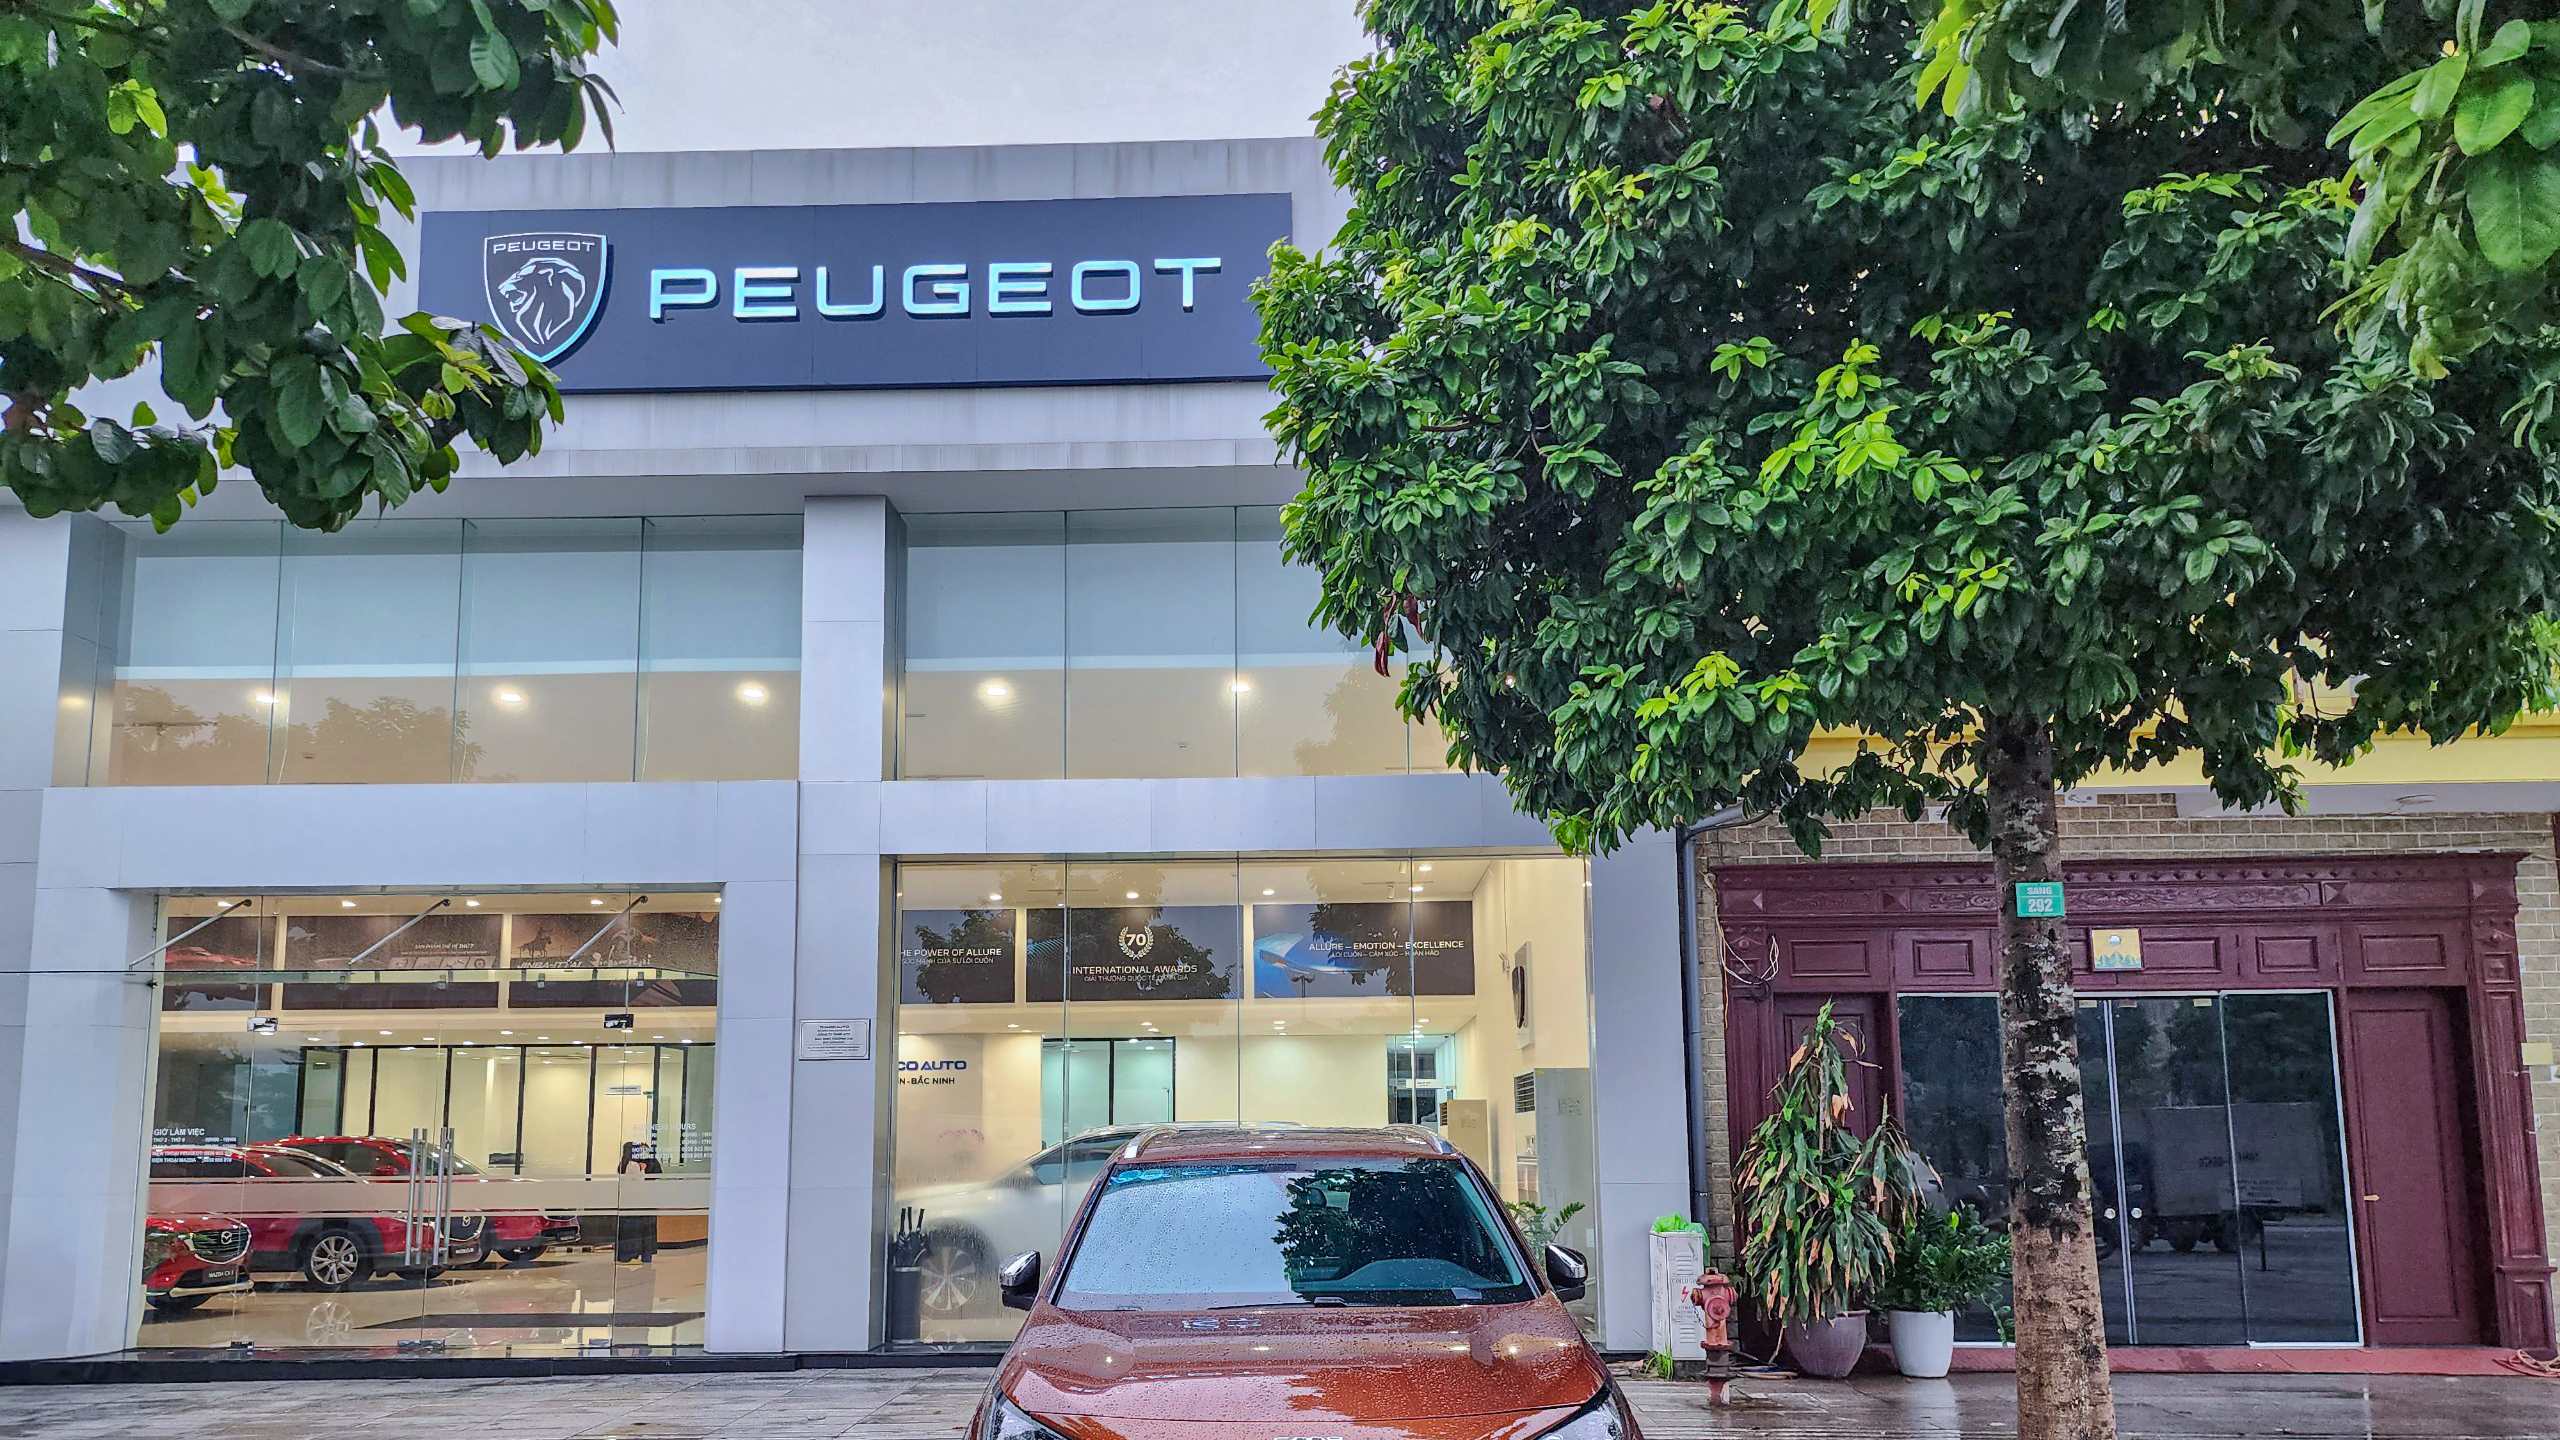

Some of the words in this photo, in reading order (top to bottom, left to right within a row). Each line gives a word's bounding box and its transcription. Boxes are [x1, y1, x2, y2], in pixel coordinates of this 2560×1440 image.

[493, 240, 595, 254] PEUGEOT
[650, 257, 1221, 319] PEUGEOT
[2028, 898, 2053, 912] 292
[1126, 934, 1146, 946] 70
[1308, 942, 1344, 951] ALLURE
[1353, 941, 1396, 950] EMOTION
[1405, 940, 1465, 950] EXCELLENCE
[914, 948, 949, 957] POWER
[951, 948, 965, 956] OF
[966, 948, 1002, 956] ALLURE
[1072, 965, 1151, 974] INTERNATIONAL
[1153, 964, 1198, 973] AWARDS
[921, 1060, 967, 1071] AUTO
[932, 1077, 955, 1085] NINH
